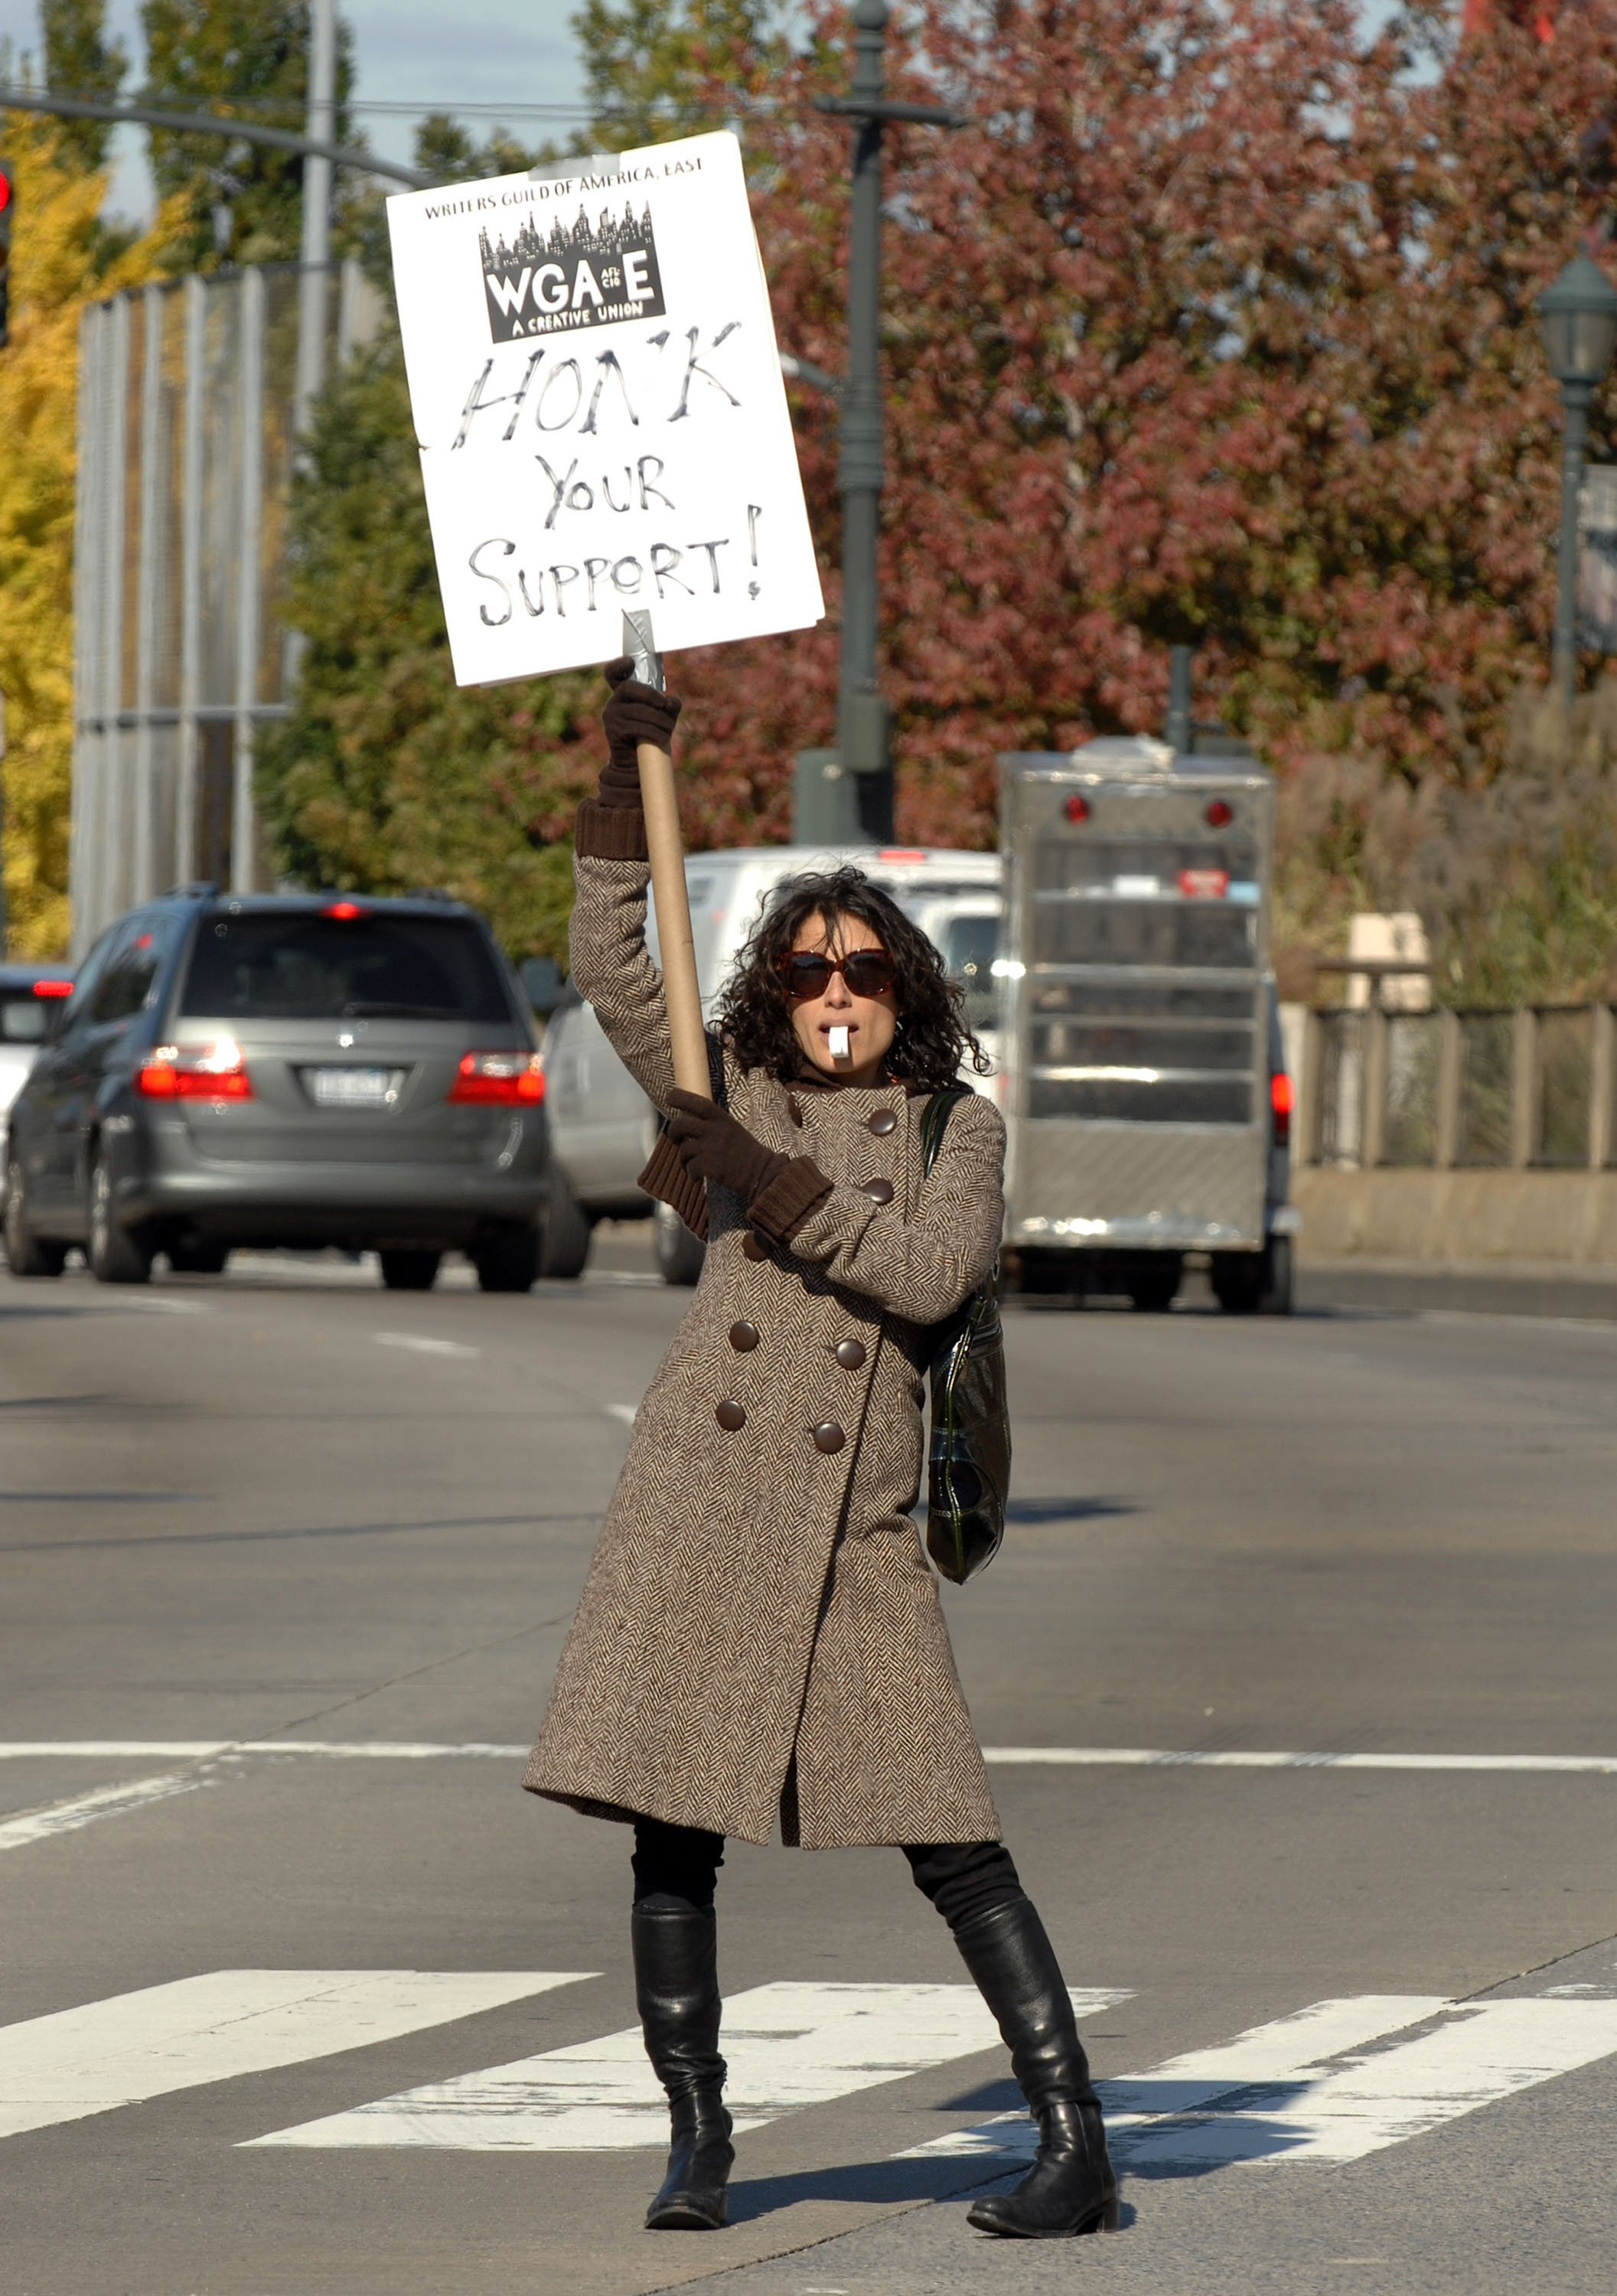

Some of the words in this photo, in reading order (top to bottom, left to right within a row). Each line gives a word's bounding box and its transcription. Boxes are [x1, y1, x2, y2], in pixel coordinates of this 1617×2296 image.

[425, 197, 497, 220] WRITERS
[501, 185, 550, 207] GUILD
[555, 179, 573, 197] OF
[664, 157, 703, 178] EAST
[601, 277, 621, 289] CIO
[512, 318, 525, 338] A
[527, 308, 592, 333] CREATIVE
[598, 300, 644, 321] UNION
[535, 455, 675, 530] YOUR
[469, 504, 762, 627] SUPPORT!
